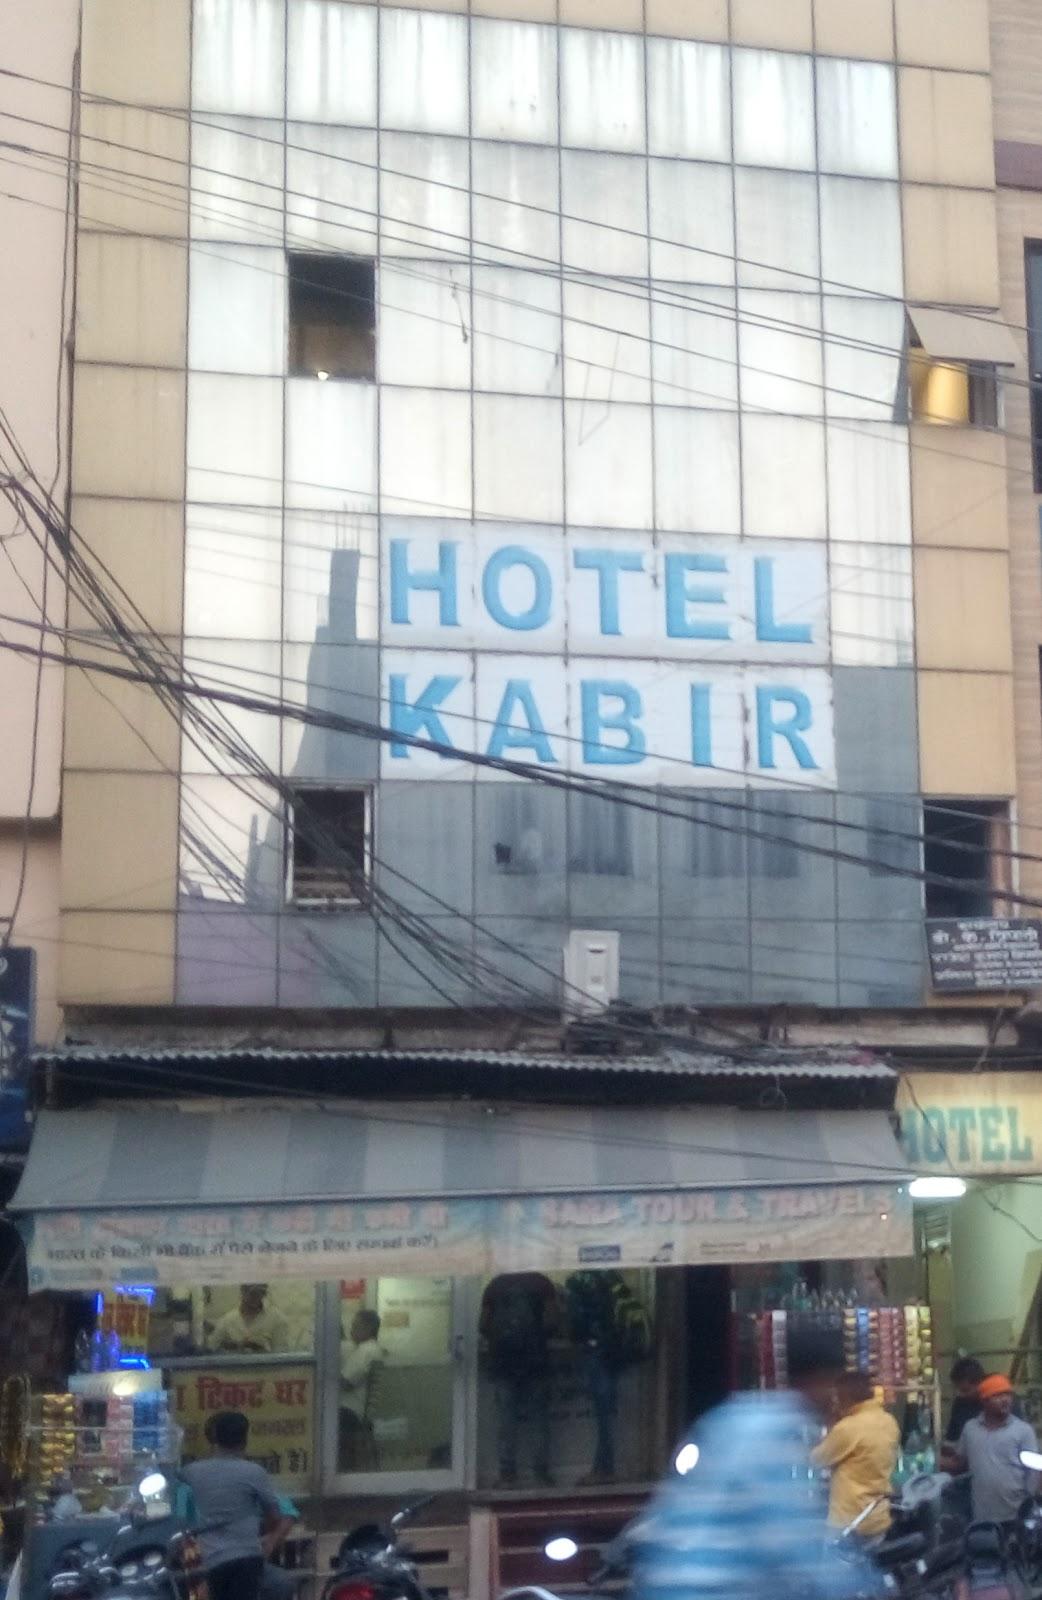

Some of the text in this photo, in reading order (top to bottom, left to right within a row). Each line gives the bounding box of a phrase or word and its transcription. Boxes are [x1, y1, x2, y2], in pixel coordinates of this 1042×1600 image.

[389, 538, 814, 643] HOTEL
[389, 673, 818, 770] KABIR
[633, 1194, 715, 1223] TOUR
[758, 1187, 892, 1218] TRAVELS
[196, 1376, 264, 1410] टिकट
[274, 1379, 308, 1406] घर
